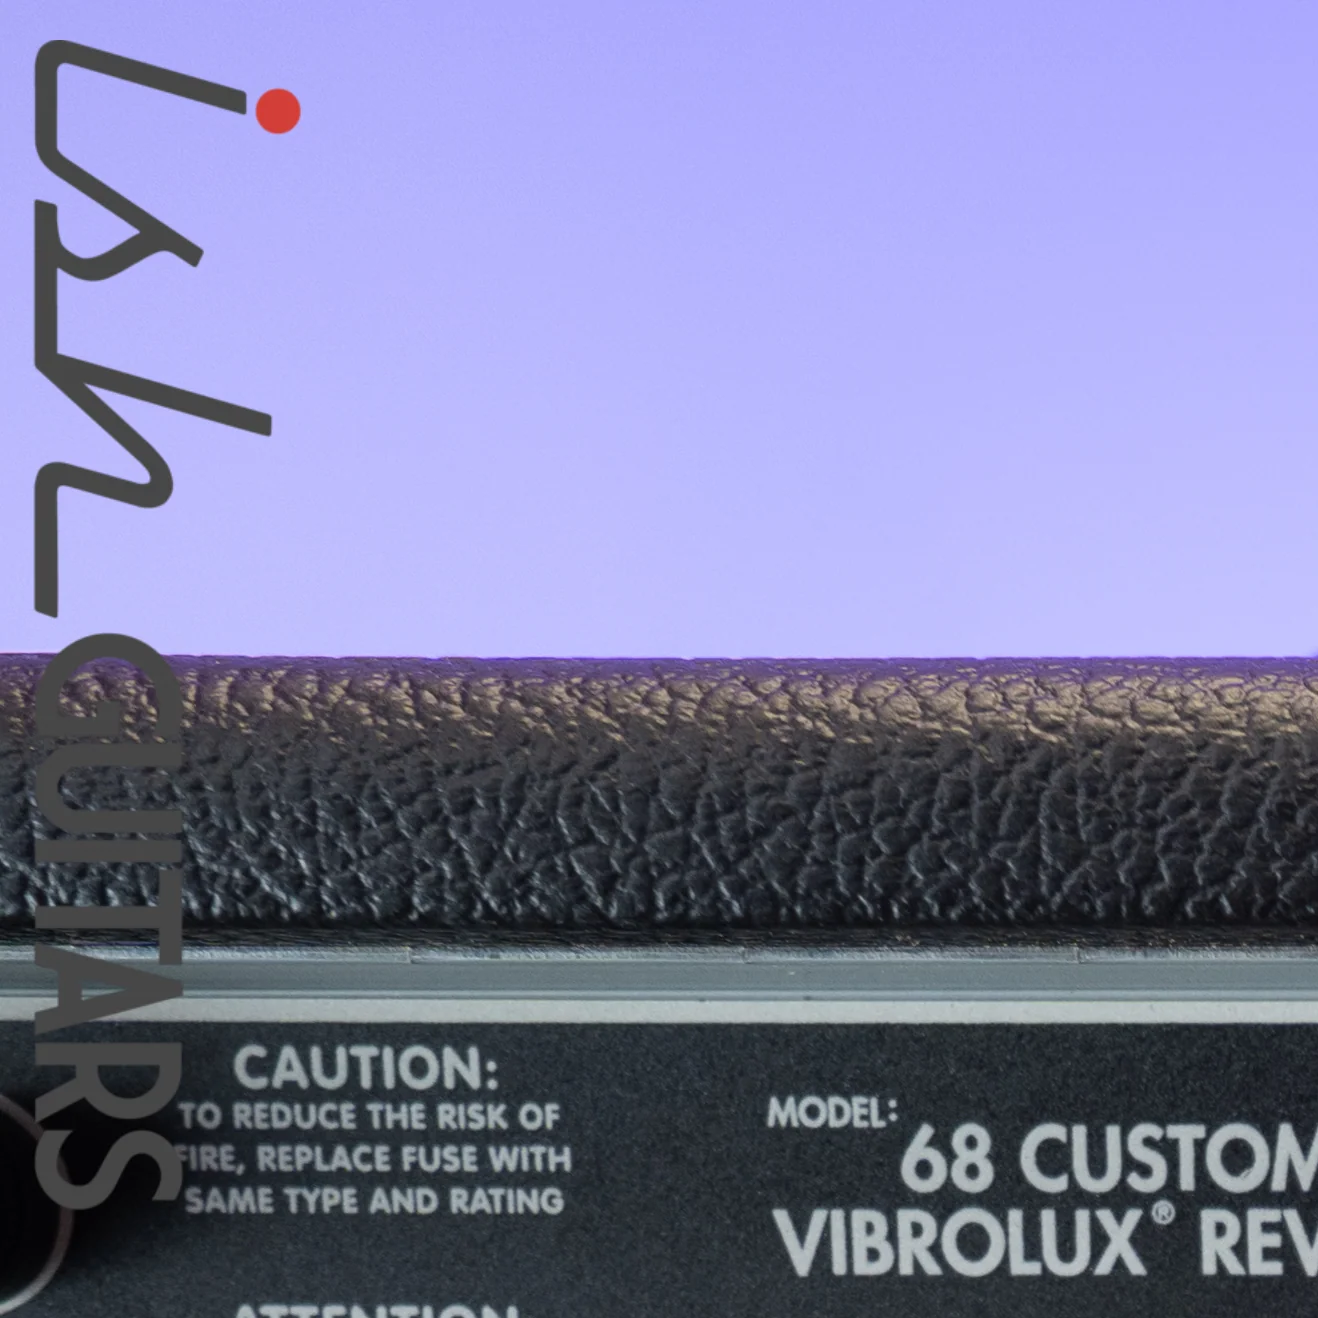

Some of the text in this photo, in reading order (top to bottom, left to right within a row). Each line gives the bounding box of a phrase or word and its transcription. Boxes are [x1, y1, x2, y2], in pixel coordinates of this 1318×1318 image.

[233, 1043, 499, 1091] CAUTION:
[177, 1101, 560, 1131] TO REDUCE THE RISK OF
[766, 1095, 898, 1129] MODEL:
[256, 1143, 392, 1173] REPLACE
[401, 1144, 479, 1173] FUSE
[487, 1144, 572, 1173] WITH
[900, 1121, 995, 1194] 68
[185, 1186, 565, 1215] SAME TYPE AND RATING
